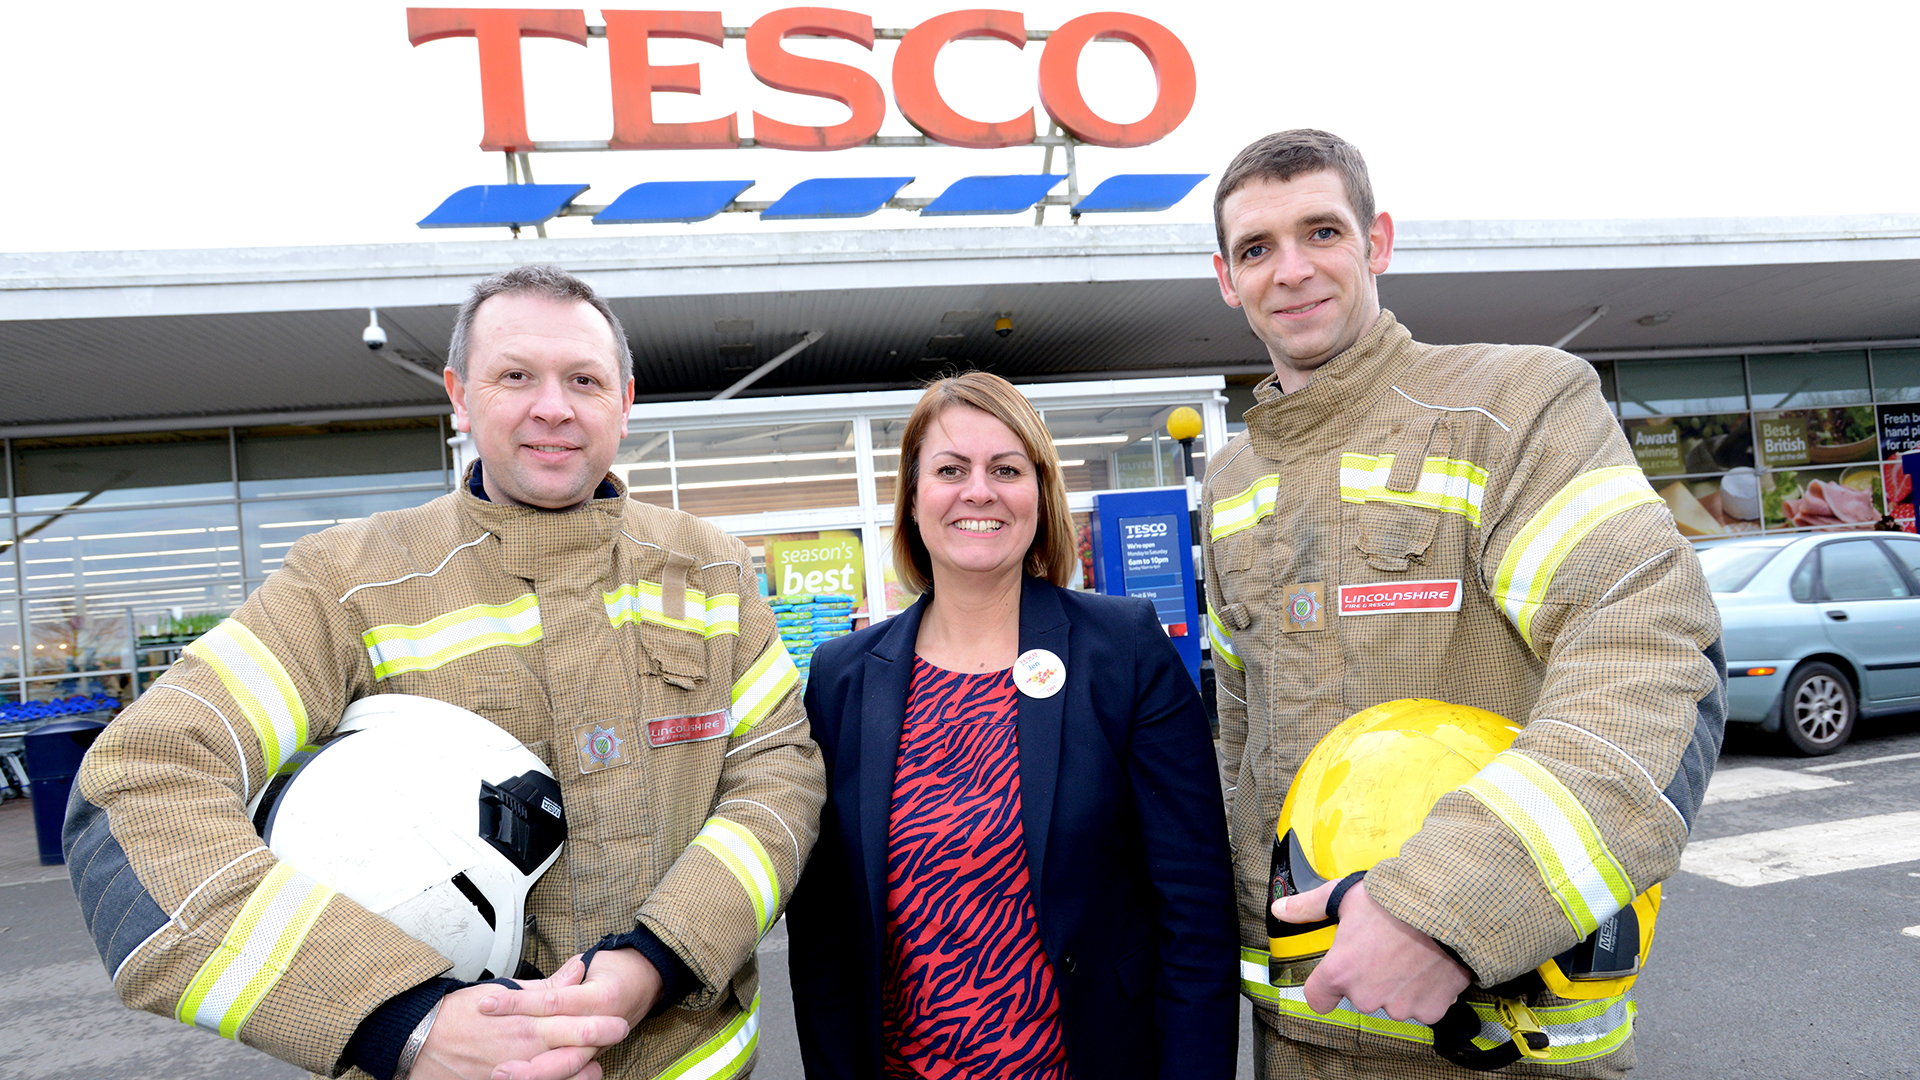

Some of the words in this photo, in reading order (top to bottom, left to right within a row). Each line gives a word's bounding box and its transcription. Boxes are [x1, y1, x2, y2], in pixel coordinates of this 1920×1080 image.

[406, 7, 1197, 151] TESCO
[1884, 413, 1911, 424] Fresh
[1763, 423, 1792, 438] Best
[1885, 425, 1910, 437] hand
[1635, 429, 1677, 446] Award
[1765, 436, 1806, 453] British
[1886, 439, 1901, 450] for
[1636, 445, 1679, 459] winning
[1117, 459, 1170, 470] DELIVERG
[1125, 522, 1167, 534] TESCO
[780, 541, 853, 564] season's
[1142, 542, 1155, 550] open
[1128, 558, 1142, 566] 6am
[1151, 556, 1169, 565] 10pm
[782, 563, 855, 595] best
[1344, 590, 1450, 603] LINCOLNSHIRE
[1028, 661, 1040, 672] Jen
[542, 799, 561, 819] MSA
